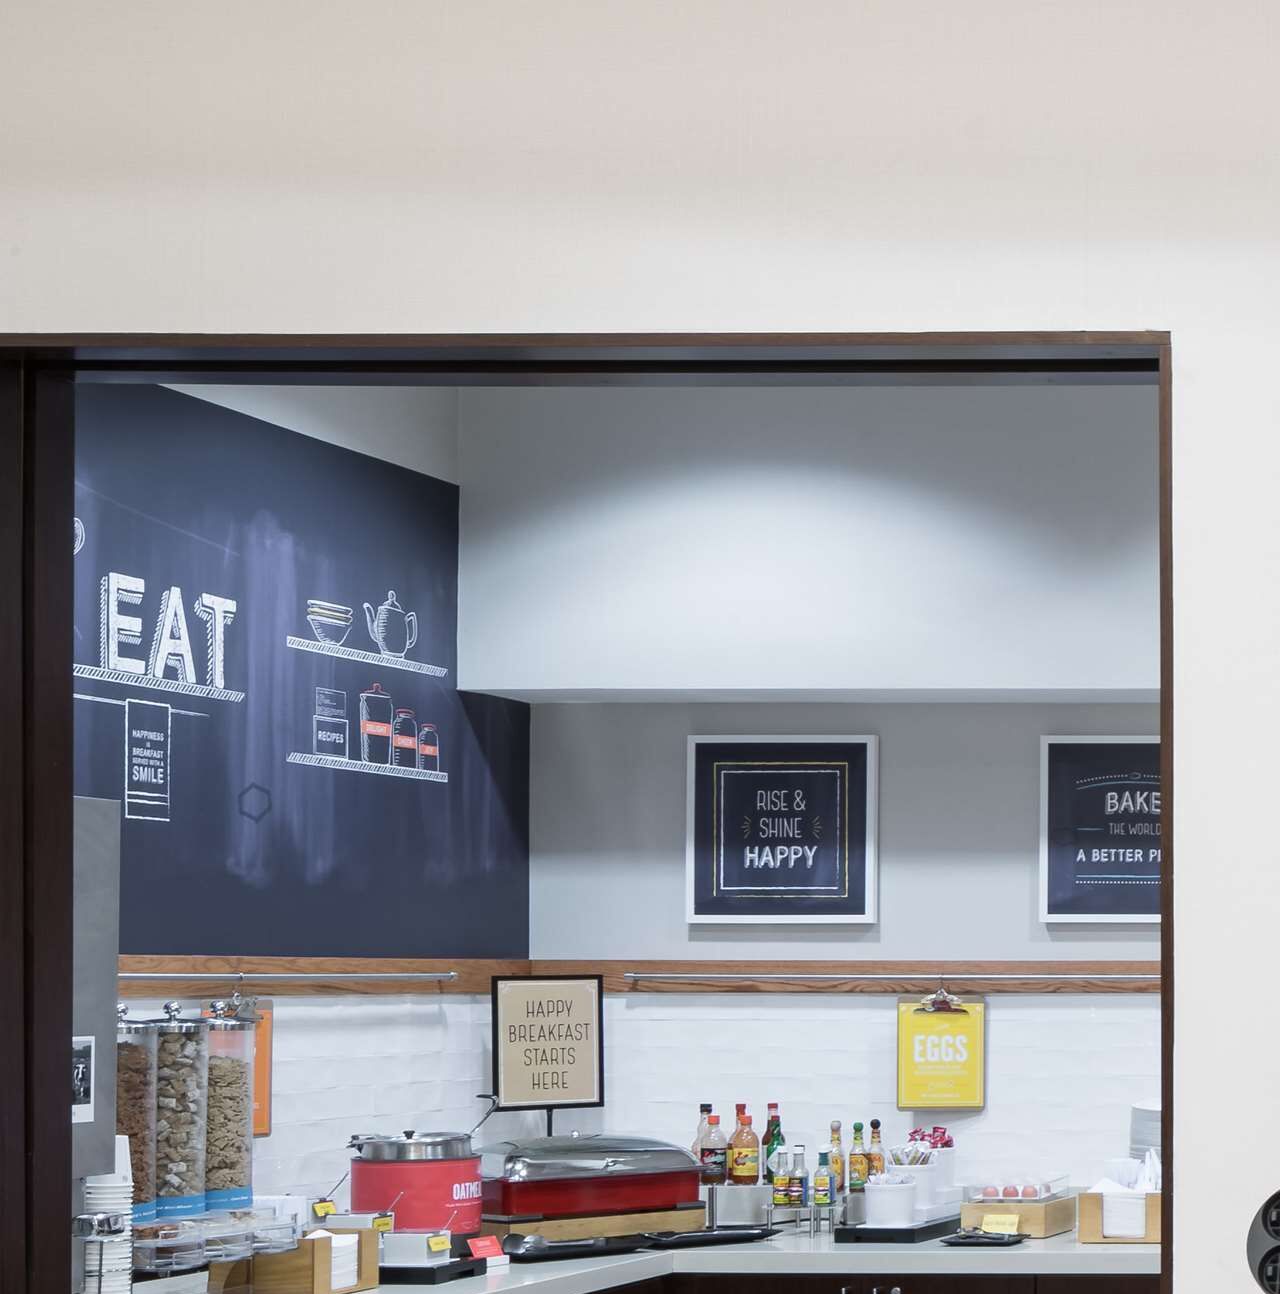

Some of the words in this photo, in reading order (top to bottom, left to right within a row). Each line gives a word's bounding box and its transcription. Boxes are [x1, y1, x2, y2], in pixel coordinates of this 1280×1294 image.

[100, 571, 237, 689] EAT
[132, 729, 165, 742] HAPPINESS
[317, 730, 344, 744] RECIPES
[132, 747, 164, 759] BREAKFAST
[132, 765, 164, 784] SMILE
[756, 790, 789, 811] RISE
[793, 789, 807, 811] &
[1104, 790, 1161, 815] BAKE
[759, 817, 802, 839] SHINE
[1108, 822, 1126, 836] THE
[743, 846, 818, 869] HAPPY
[1076, 849, 1086, 862] A
[1091, 849, 1143, 862] BETTER
[526, 1000, 573, 1018] HAPPY
[508, 1023, 592, 1043] BREAKFAST
[523, 1047, 576, 1067] STARTS
[913, 1034, 969, 1063] EGGS
[532, 1071, 569, 1090] HERE
